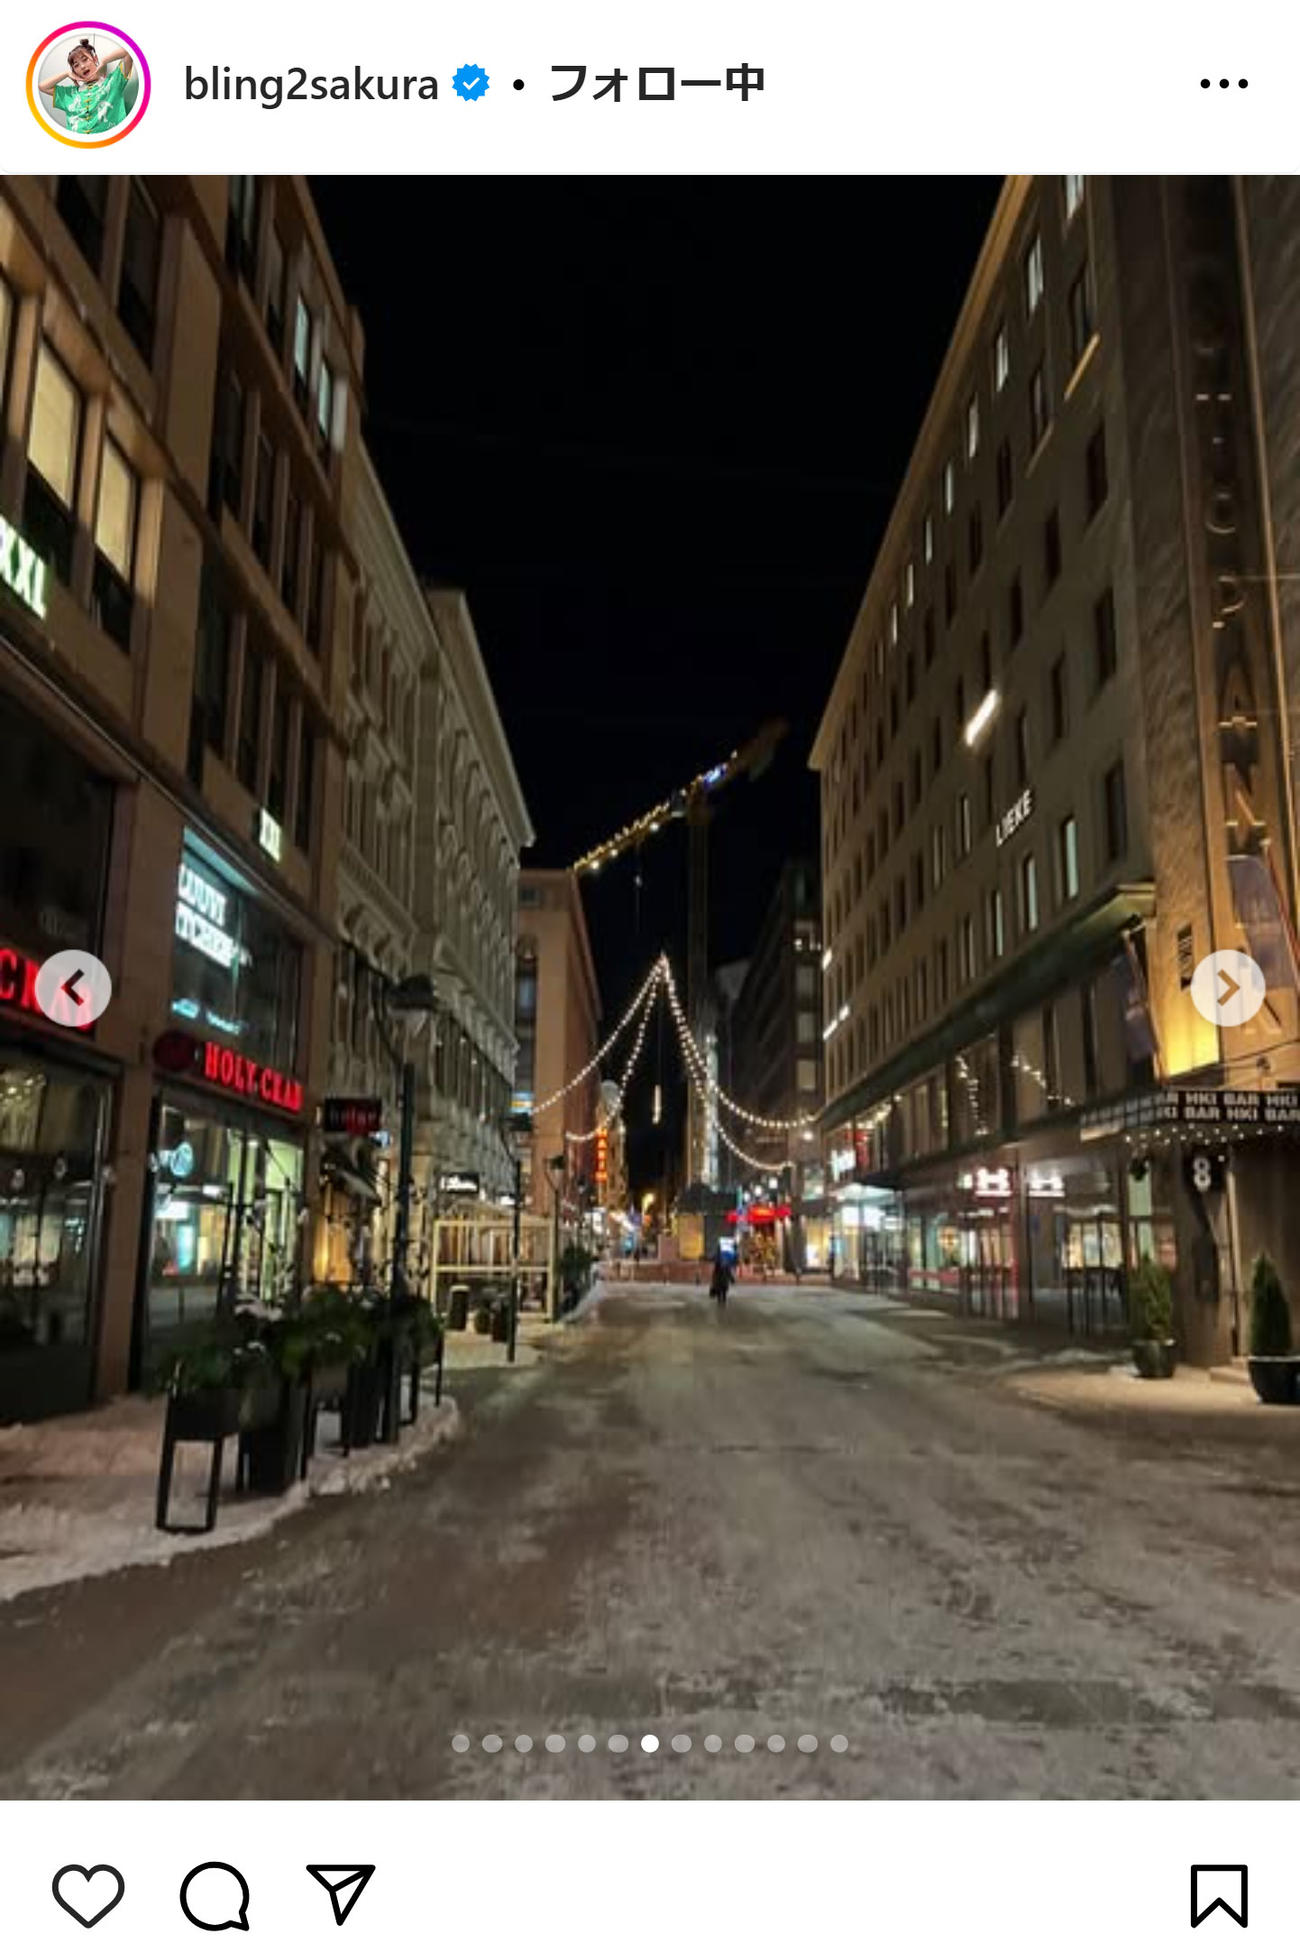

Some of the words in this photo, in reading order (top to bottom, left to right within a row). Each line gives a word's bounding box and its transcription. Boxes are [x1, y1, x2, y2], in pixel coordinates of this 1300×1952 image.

[204, 1040, 258, 1095] HOLY
[1223, 1092, 1260, 1106] BAR
[1184, 1106, 1221, 1120] BAR
[1193, 1156, 1212, 1192] 8
